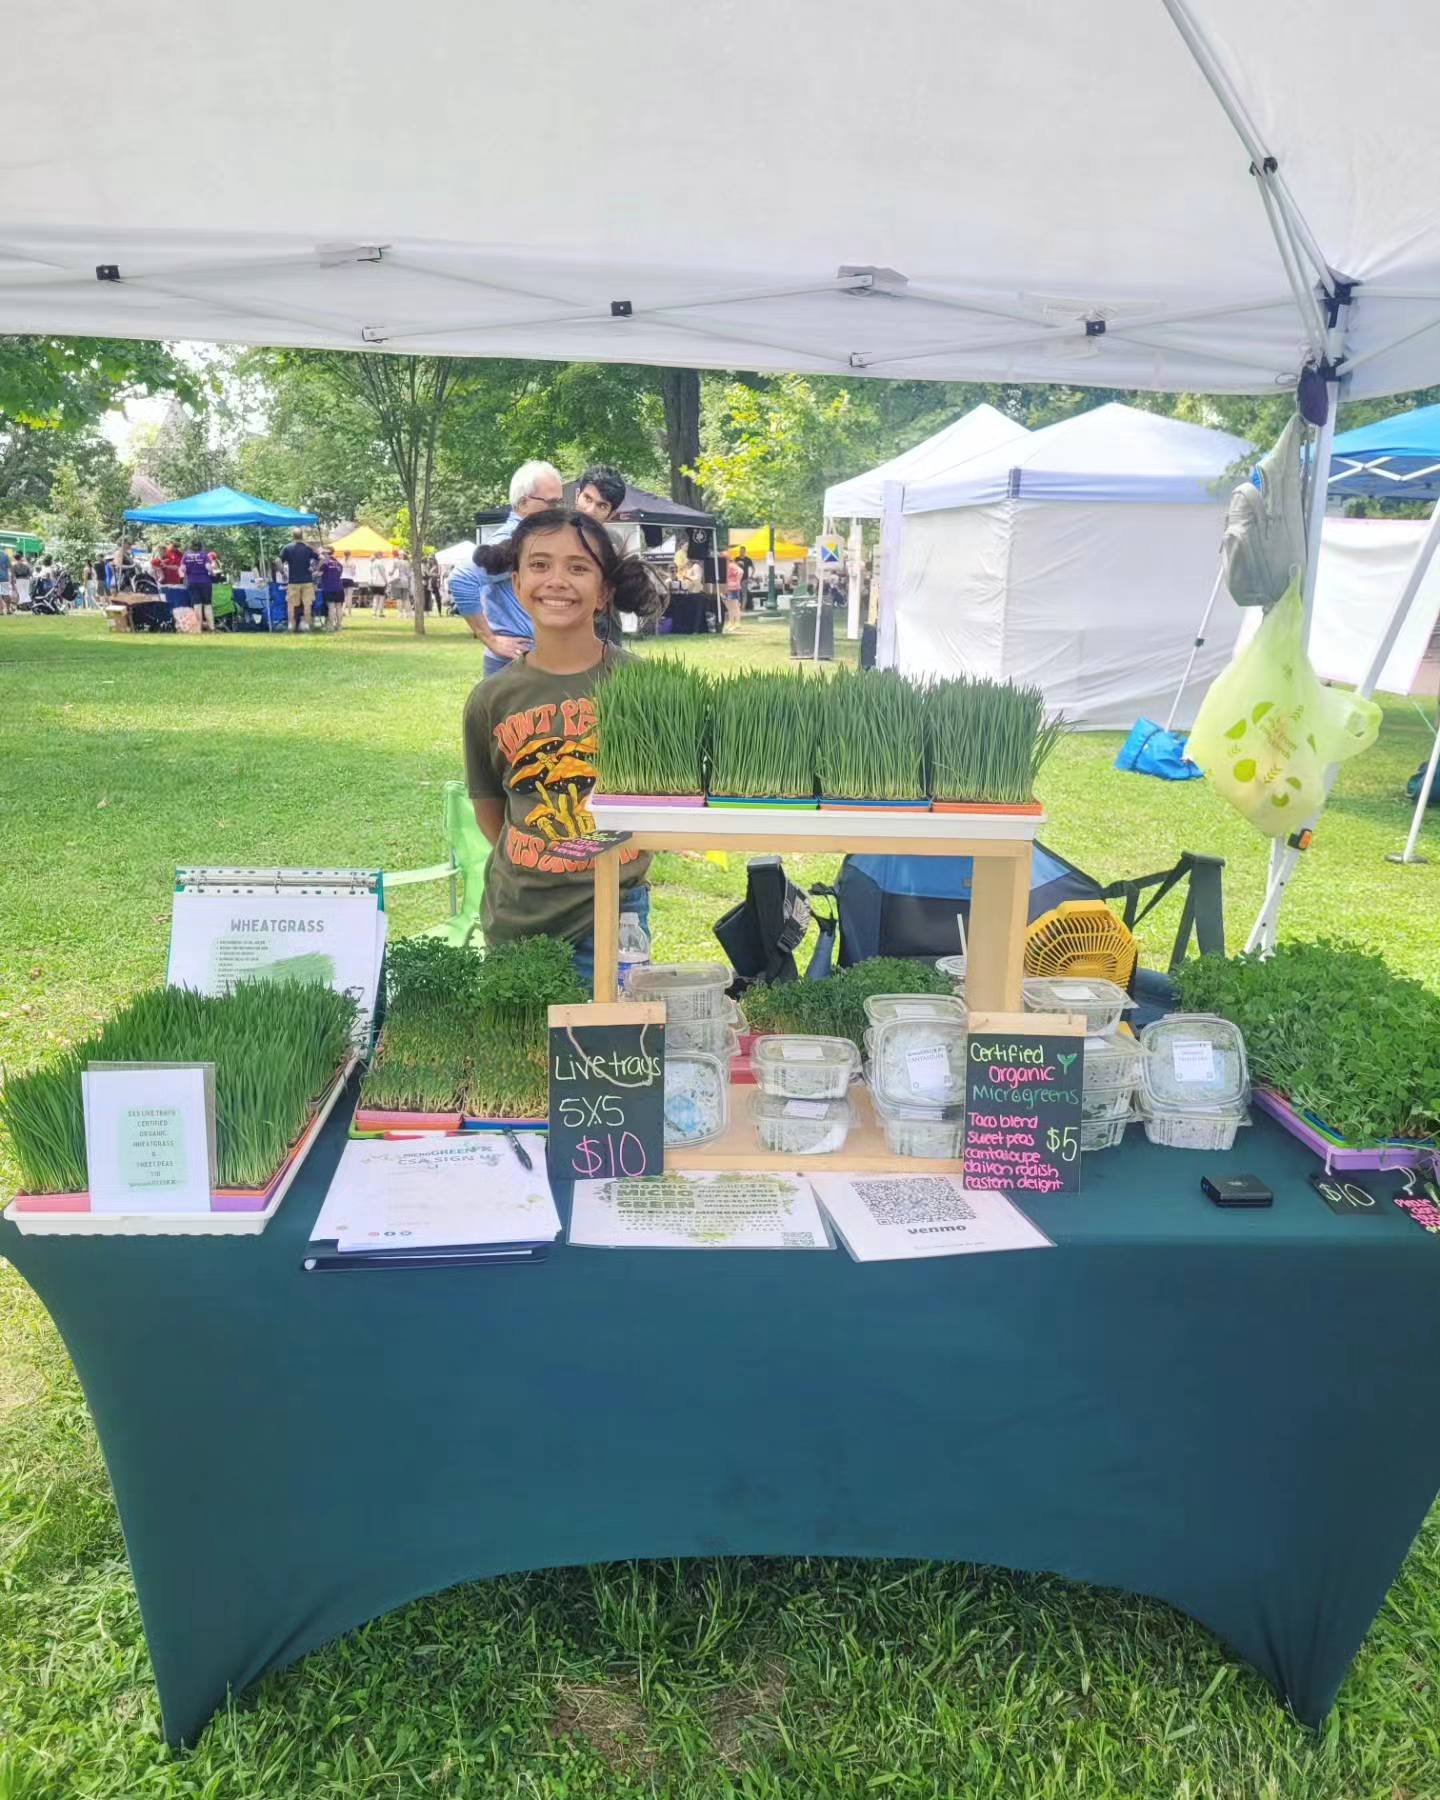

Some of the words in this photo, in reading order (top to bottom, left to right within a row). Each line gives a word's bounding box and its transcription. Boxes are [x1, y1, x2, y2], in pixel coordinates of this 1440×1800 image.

[230, 919, 325, 933] WHEATGRASS
[970, 1042, 1044, 1064] Certified
[555, 1054, 606, 1081] Live
[608, 1051, 661, 1078] trays
[988, 1065, 1056, 1089] Organic
[972, 1084, 1080, 1110] Microgreens
[968, 1112, 998, 1128] Taco
[999, 1114, 1039, 1129] blend
[1006, 1134, 1035, 1149] peas
[1046, 1126, 1080, 1162] $5
[572, 1131, 646, 1178] $10
[964, 1159, 1014, 1176] daikon
[1015, 1164, 1059, 1179] radish
[617, 1189, 694, 1197] MICRO
[1319, 1183, 1376, 1207] $10
[617, 1201, 695, 1209] GREEN
[907, 1225, 967, 1234] venmo
